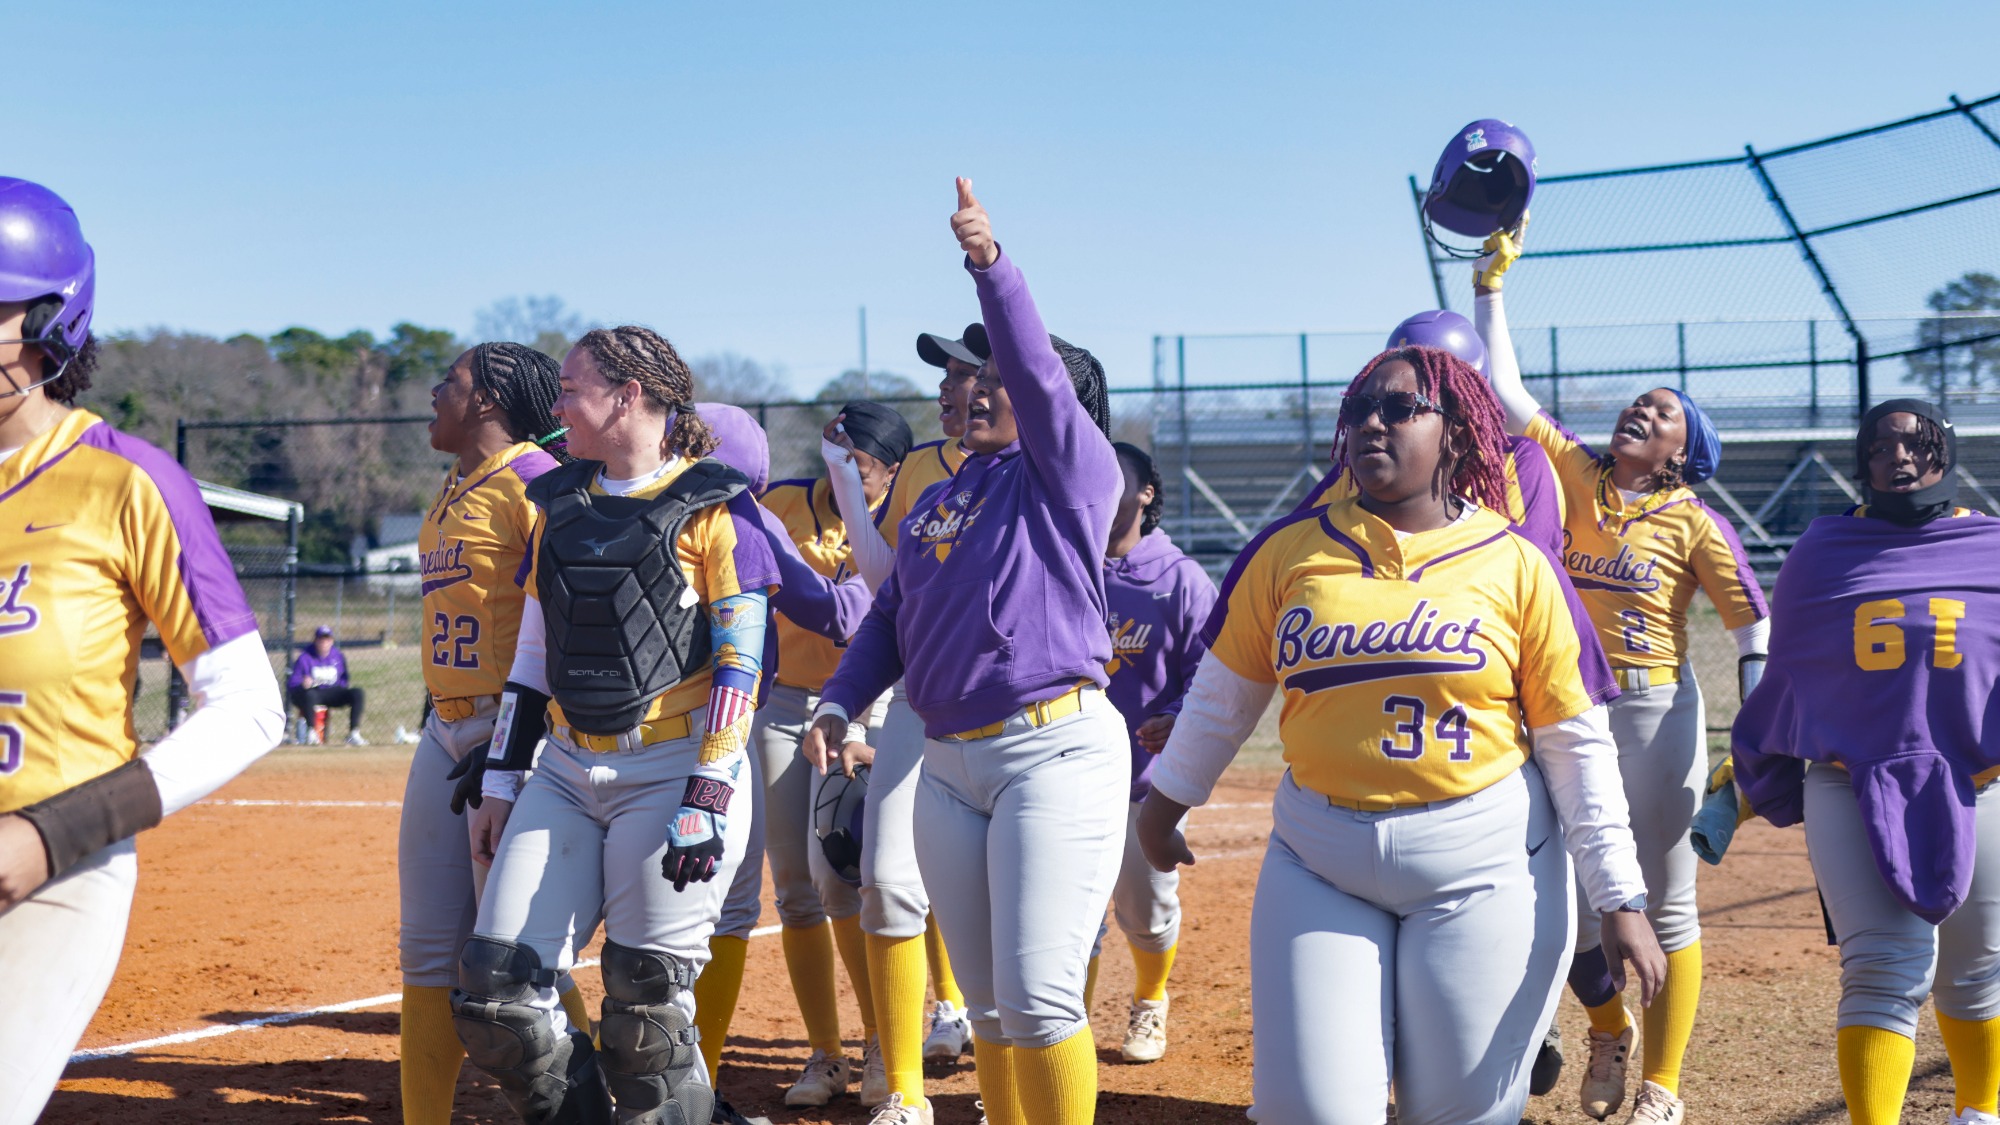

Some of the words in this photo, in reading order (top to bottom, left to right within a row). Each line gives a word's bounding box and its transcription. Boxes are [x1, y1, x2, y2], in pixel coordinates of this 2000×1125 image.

[432, 611, 481, 669] 22
[1275, 599, 1484, 672] Benedict
[1620, 610, 1651, 653] 2
[1381, 694, 1473, 762] 34
